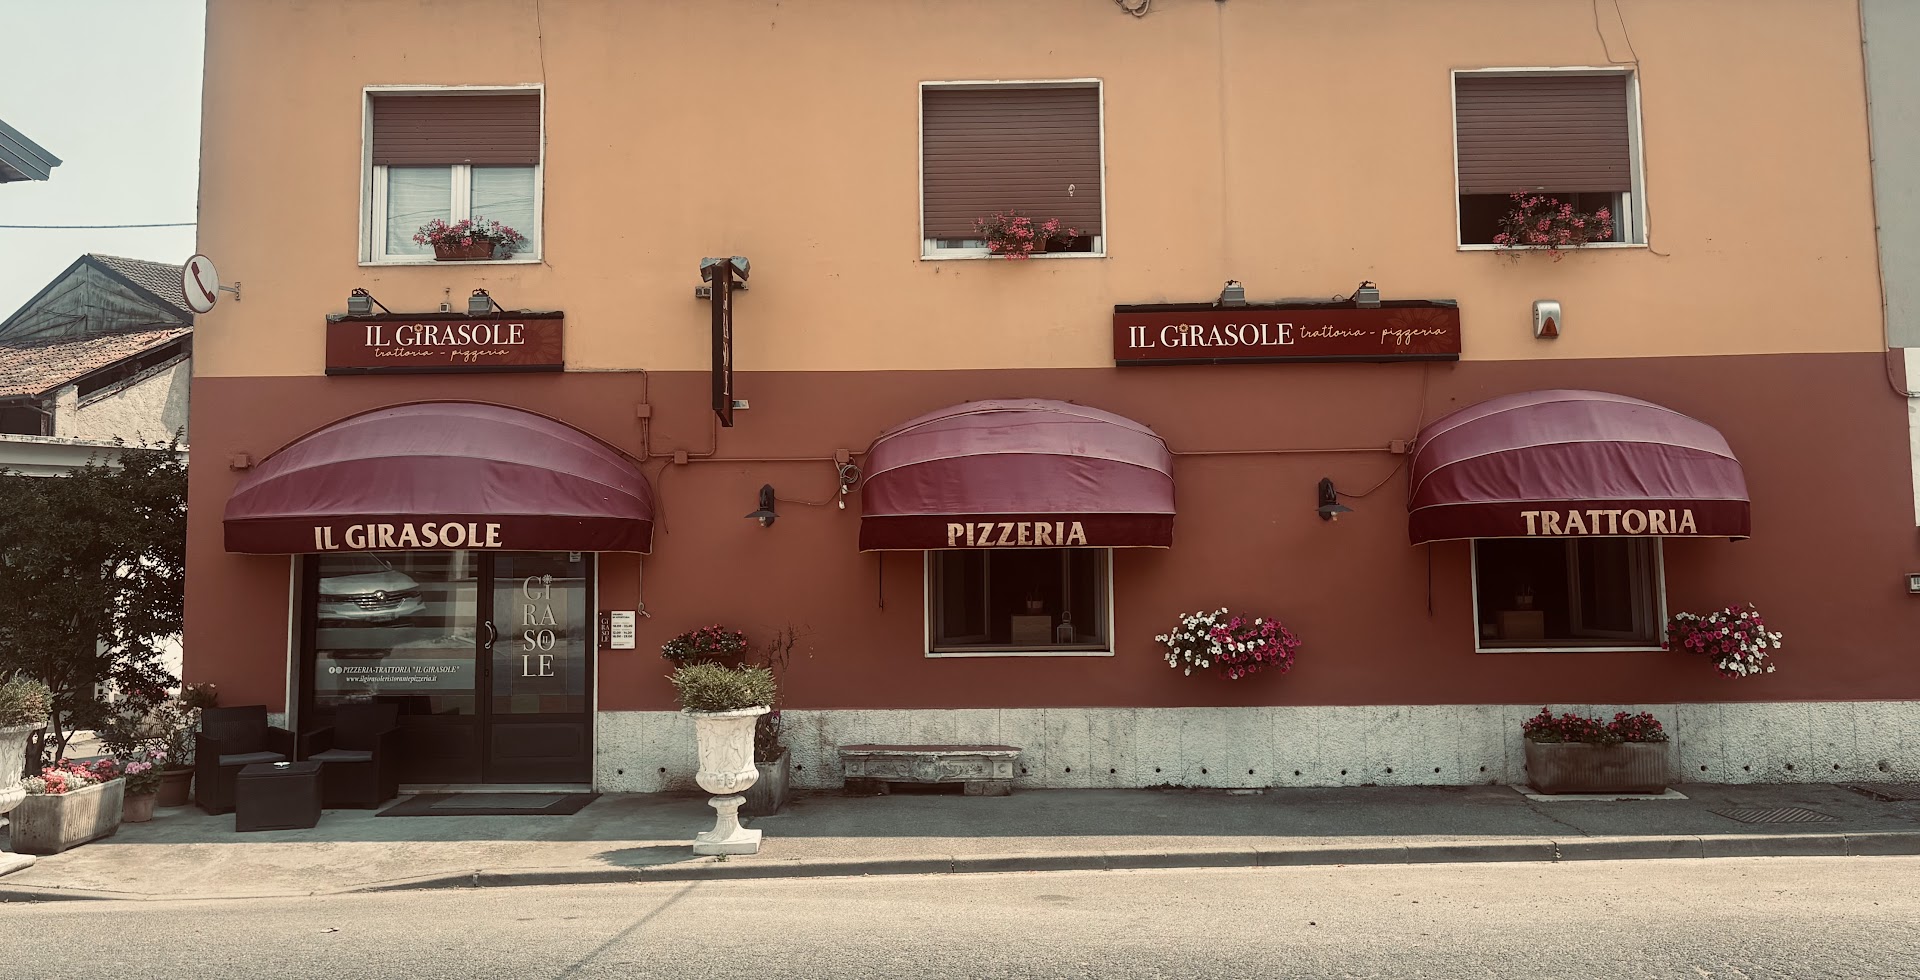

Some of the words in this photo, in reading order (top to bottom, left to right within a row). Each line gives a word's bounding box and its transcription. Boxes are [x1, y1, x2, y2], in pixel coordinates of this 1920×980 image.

[364, 325, 390, 347] IL
[1128, 325, 1155, 348] IL
[1300, 325, 1366, 339] trattoria
[1380, 326, 1448, 345] pizzeria
[374, 347, 434, 358] trattoria
[450, 348, 510, 362] pizzeria
[1520, 509, 1698, 535] TRATTORIA
[314, 526, 339, 550] IL
[344, 522, 503, 549] GIRASOLE
[947, 521, 1088, 547] PIZZERIA
[522, 603, 558, 626] RA
[523, 629, 557, 651] SO
[521, 654, 555, 677] LE
